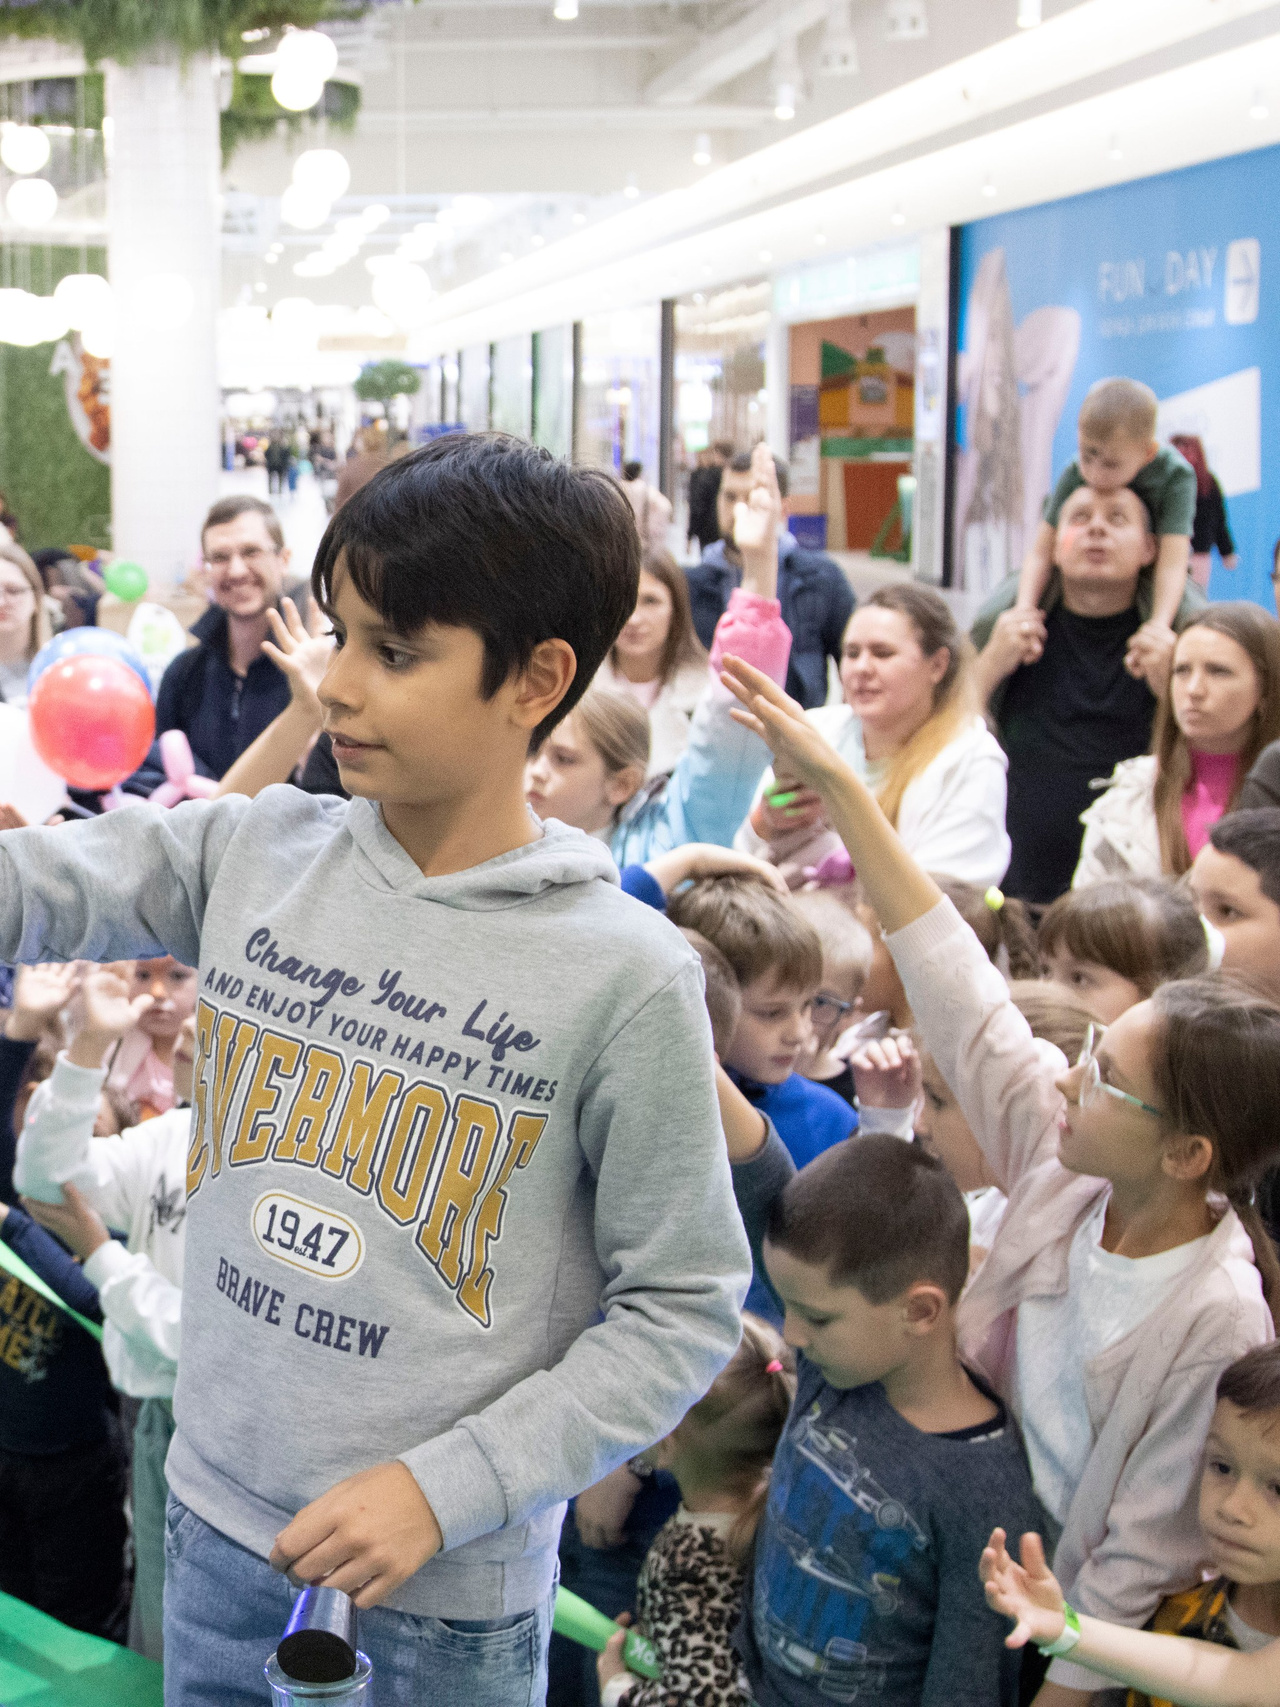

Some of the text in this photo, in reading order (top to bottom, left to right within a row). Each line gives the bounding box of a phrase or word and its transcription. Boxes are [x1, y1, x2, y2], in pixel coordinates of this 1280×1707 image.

[1166, 248, 1217, 295] DAY
[204, 966, 559, 1103] AND ENJOY YOUR HAPPY TIMES
[246, 927, 540, 1062] Change Your Life
[262, 1203, 350, 1268] 1947
[217, 1256, 390, 1359] BRAVE CREW
